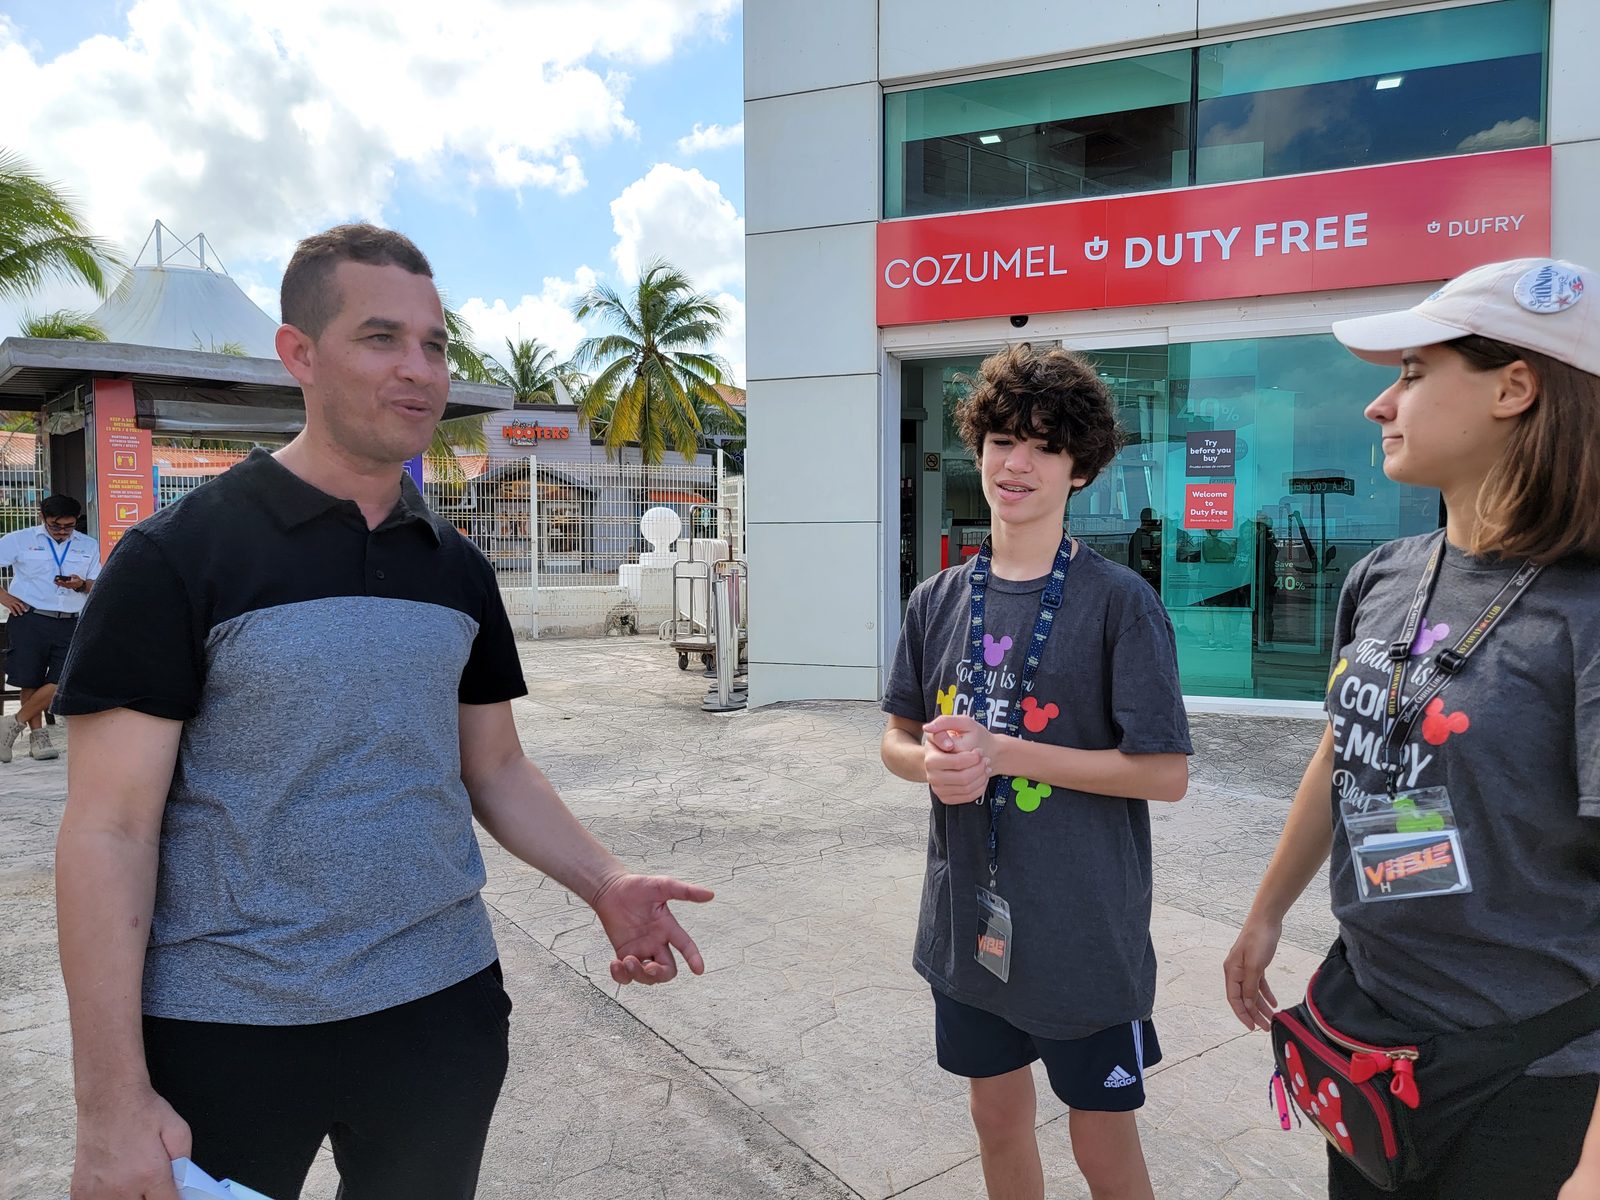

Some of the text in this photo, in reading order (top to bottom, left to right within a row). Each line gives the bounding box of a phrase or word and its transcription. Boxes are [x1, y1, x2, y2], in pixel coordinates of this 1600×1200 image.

[1448, 214, 1525, 237] DUFRY
[884, 212, 1368, 289] COZUMEL DUTY FREE
[502, 425, 570, 440] HOOTERS
[1204, 439, 1218, 448] Try
[1190, 447, 1216, 455] before
[1217, 448, 1232, 456] you
[1203, 455, 1218, 463] buy
[1190, 508, 1228, 517] Duty Free
[1274, 560, 1294, 568] Save
[1274, 576, 1306, 591] 40%
[1457, 627, 1483, 655] STAWAY
[1355, 638, 1434, 686] Tod is
[955, 659, 998, 695] Toy
[999, 664, 1017, 690] is
[1103, 1075, 1137, 1088] adidas
